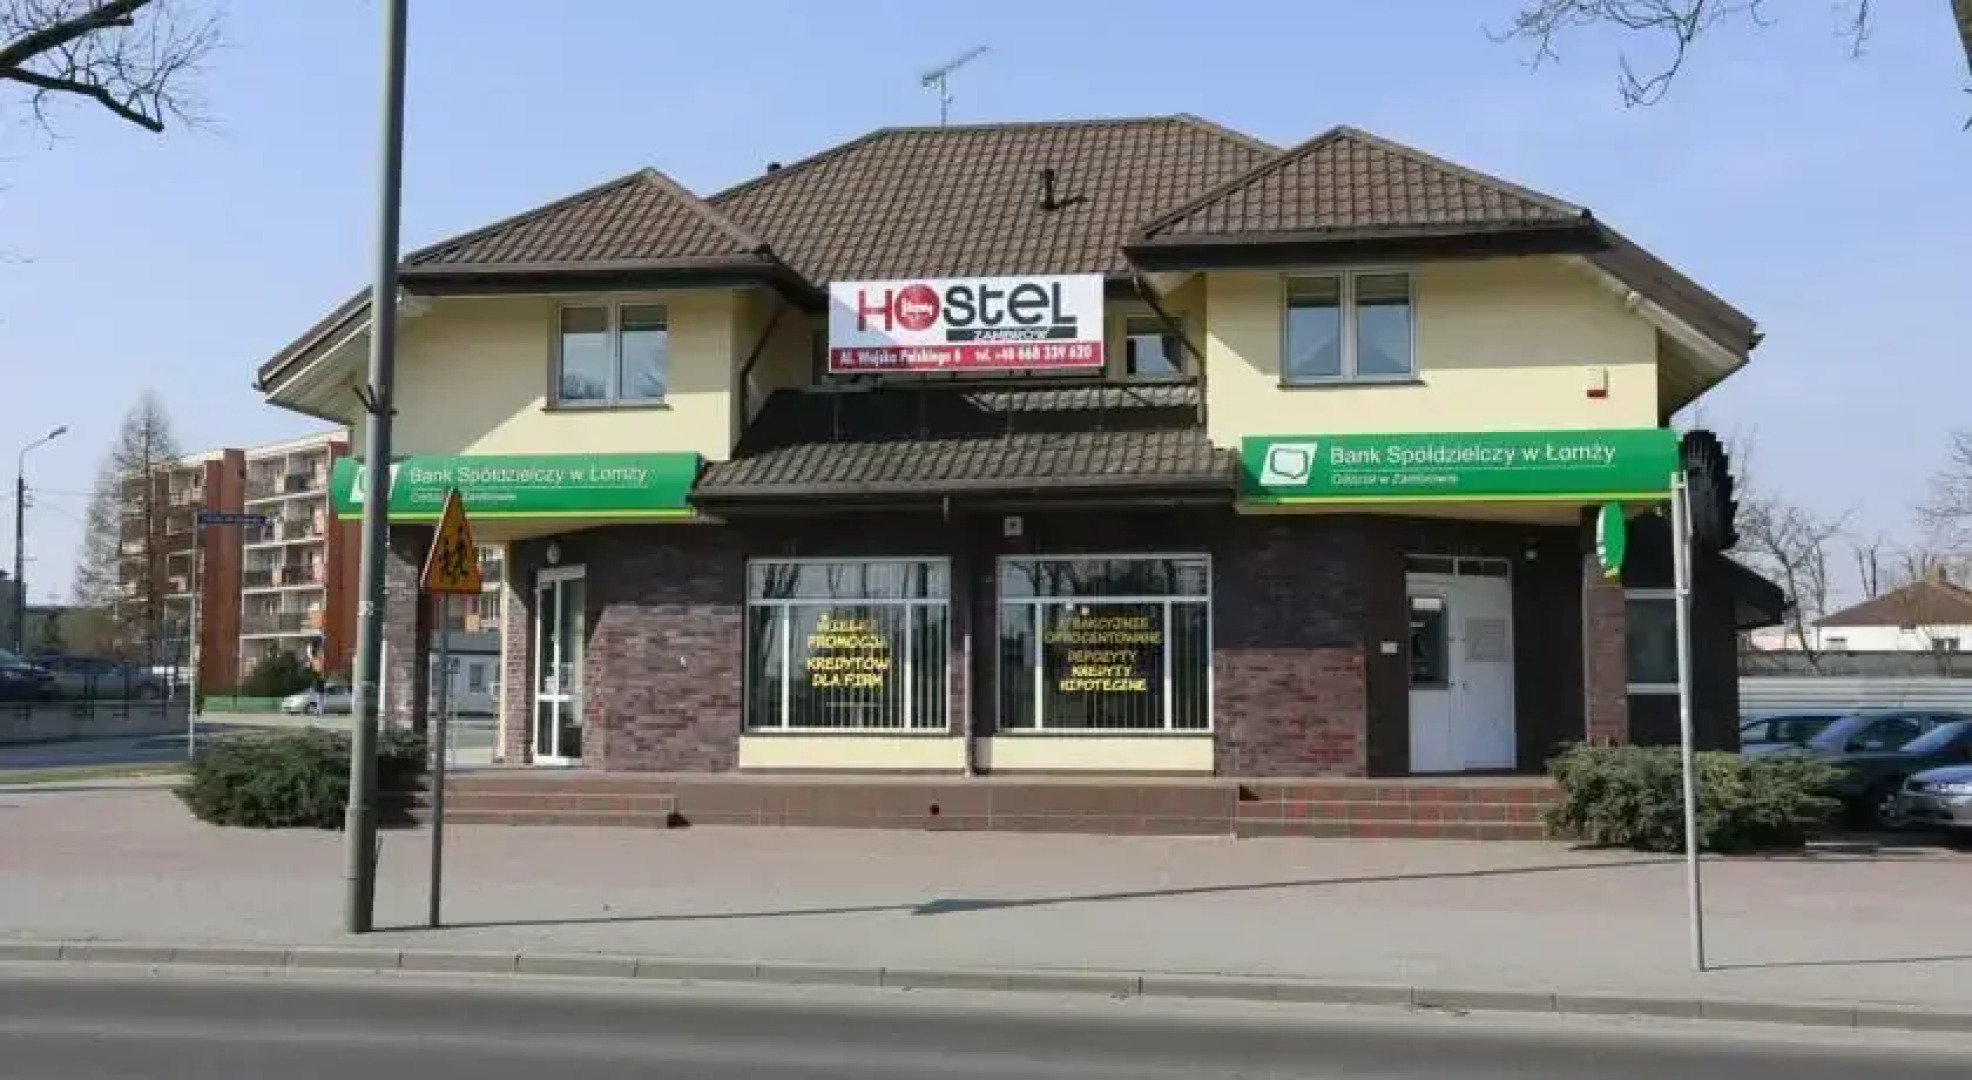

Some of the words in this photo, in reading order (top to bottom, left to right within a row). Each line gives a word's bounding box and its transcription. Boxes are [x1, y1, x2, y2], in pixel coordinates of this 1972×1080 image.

[858, 348, 898, 367] Wojska
[901, 347, 953, 367] Polskiego
[976, 347, 992, 361] tel.
[1330, 446, 1381, 465] Bank
[1387, 443, 1515, 467] Spółdzielczy
[1521, 449, 1539, 461] w
[1546, 443, 1616, 464] Łomży
[410, 466, 452, 484] Bank
[569, 468, 583, 482] w
[811, 673, 840, 687] DLA
